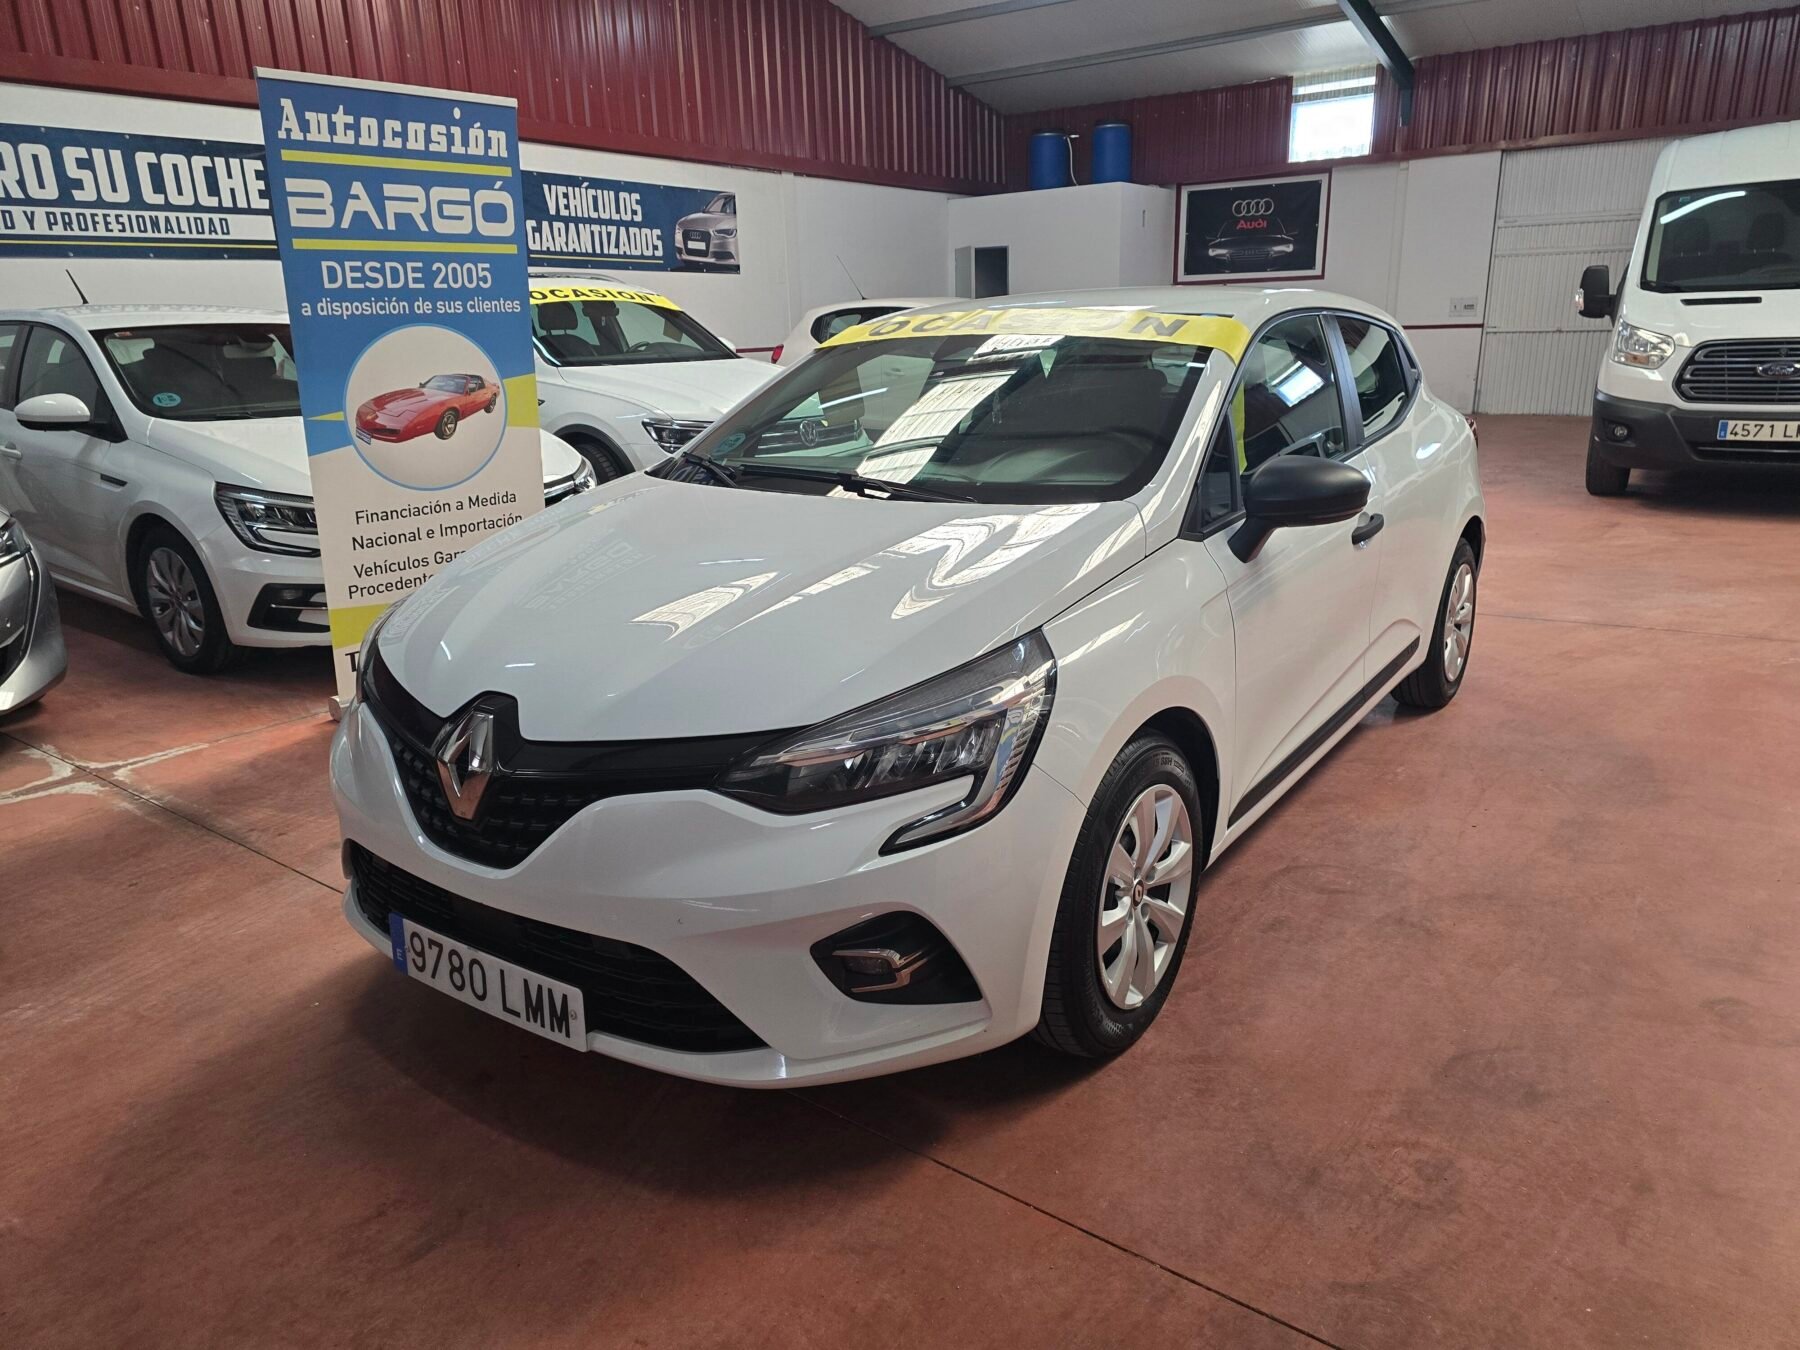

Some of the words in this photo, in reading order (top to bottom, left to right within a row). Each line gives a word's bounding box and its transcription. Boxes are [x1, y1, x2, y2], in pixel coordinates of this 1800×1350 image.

[278, 98, 508, 158] Autocasión
[62, 146, 130, 203] SU
[135, 151, 269, 209] COCHE
[284, 178, 515, 237] BARGÓ
[543, 182, 642, 222] VEHÍCULOS
[23, 211, 35, 231] Y
[46, 211, 231, 235] PROFESIONALIDAD
[1236, 219, 1267, 230] Audi
[526, 220, 663, 257] GARANTIZADOS
[321, 261, 425, 289] DESDE
[432, 263, 491, 289] 2005
[301, 301, 311, 316] a
[317, 298, 409, 319] disposición
[414, 299, 432, 314] de
[437, 301, 463, 313] sus
[467, 298, 521, 313] clientes
[529, 288, 656, 304] OCASION
[868, 312, 1190, 337] OCASON
[1729, 423, 1775, 438] 4571
[355, 500, 451, 525] Financiación
[456, 500, 464, 511] a
[468, 491, 517, 509] Medida
[352, 527, 422, 551] Nacional
[426, 528, 435, 539] e
[440, 512, 523, 537] Importación
[353, 556, 430, 579] Vehículos
[434, 550, 467, 565] Gar
[348, 573, 434, 600] Procedent
[409, 931, 487, 1001] 9780
[500, 969, 570, 1038] LMM
